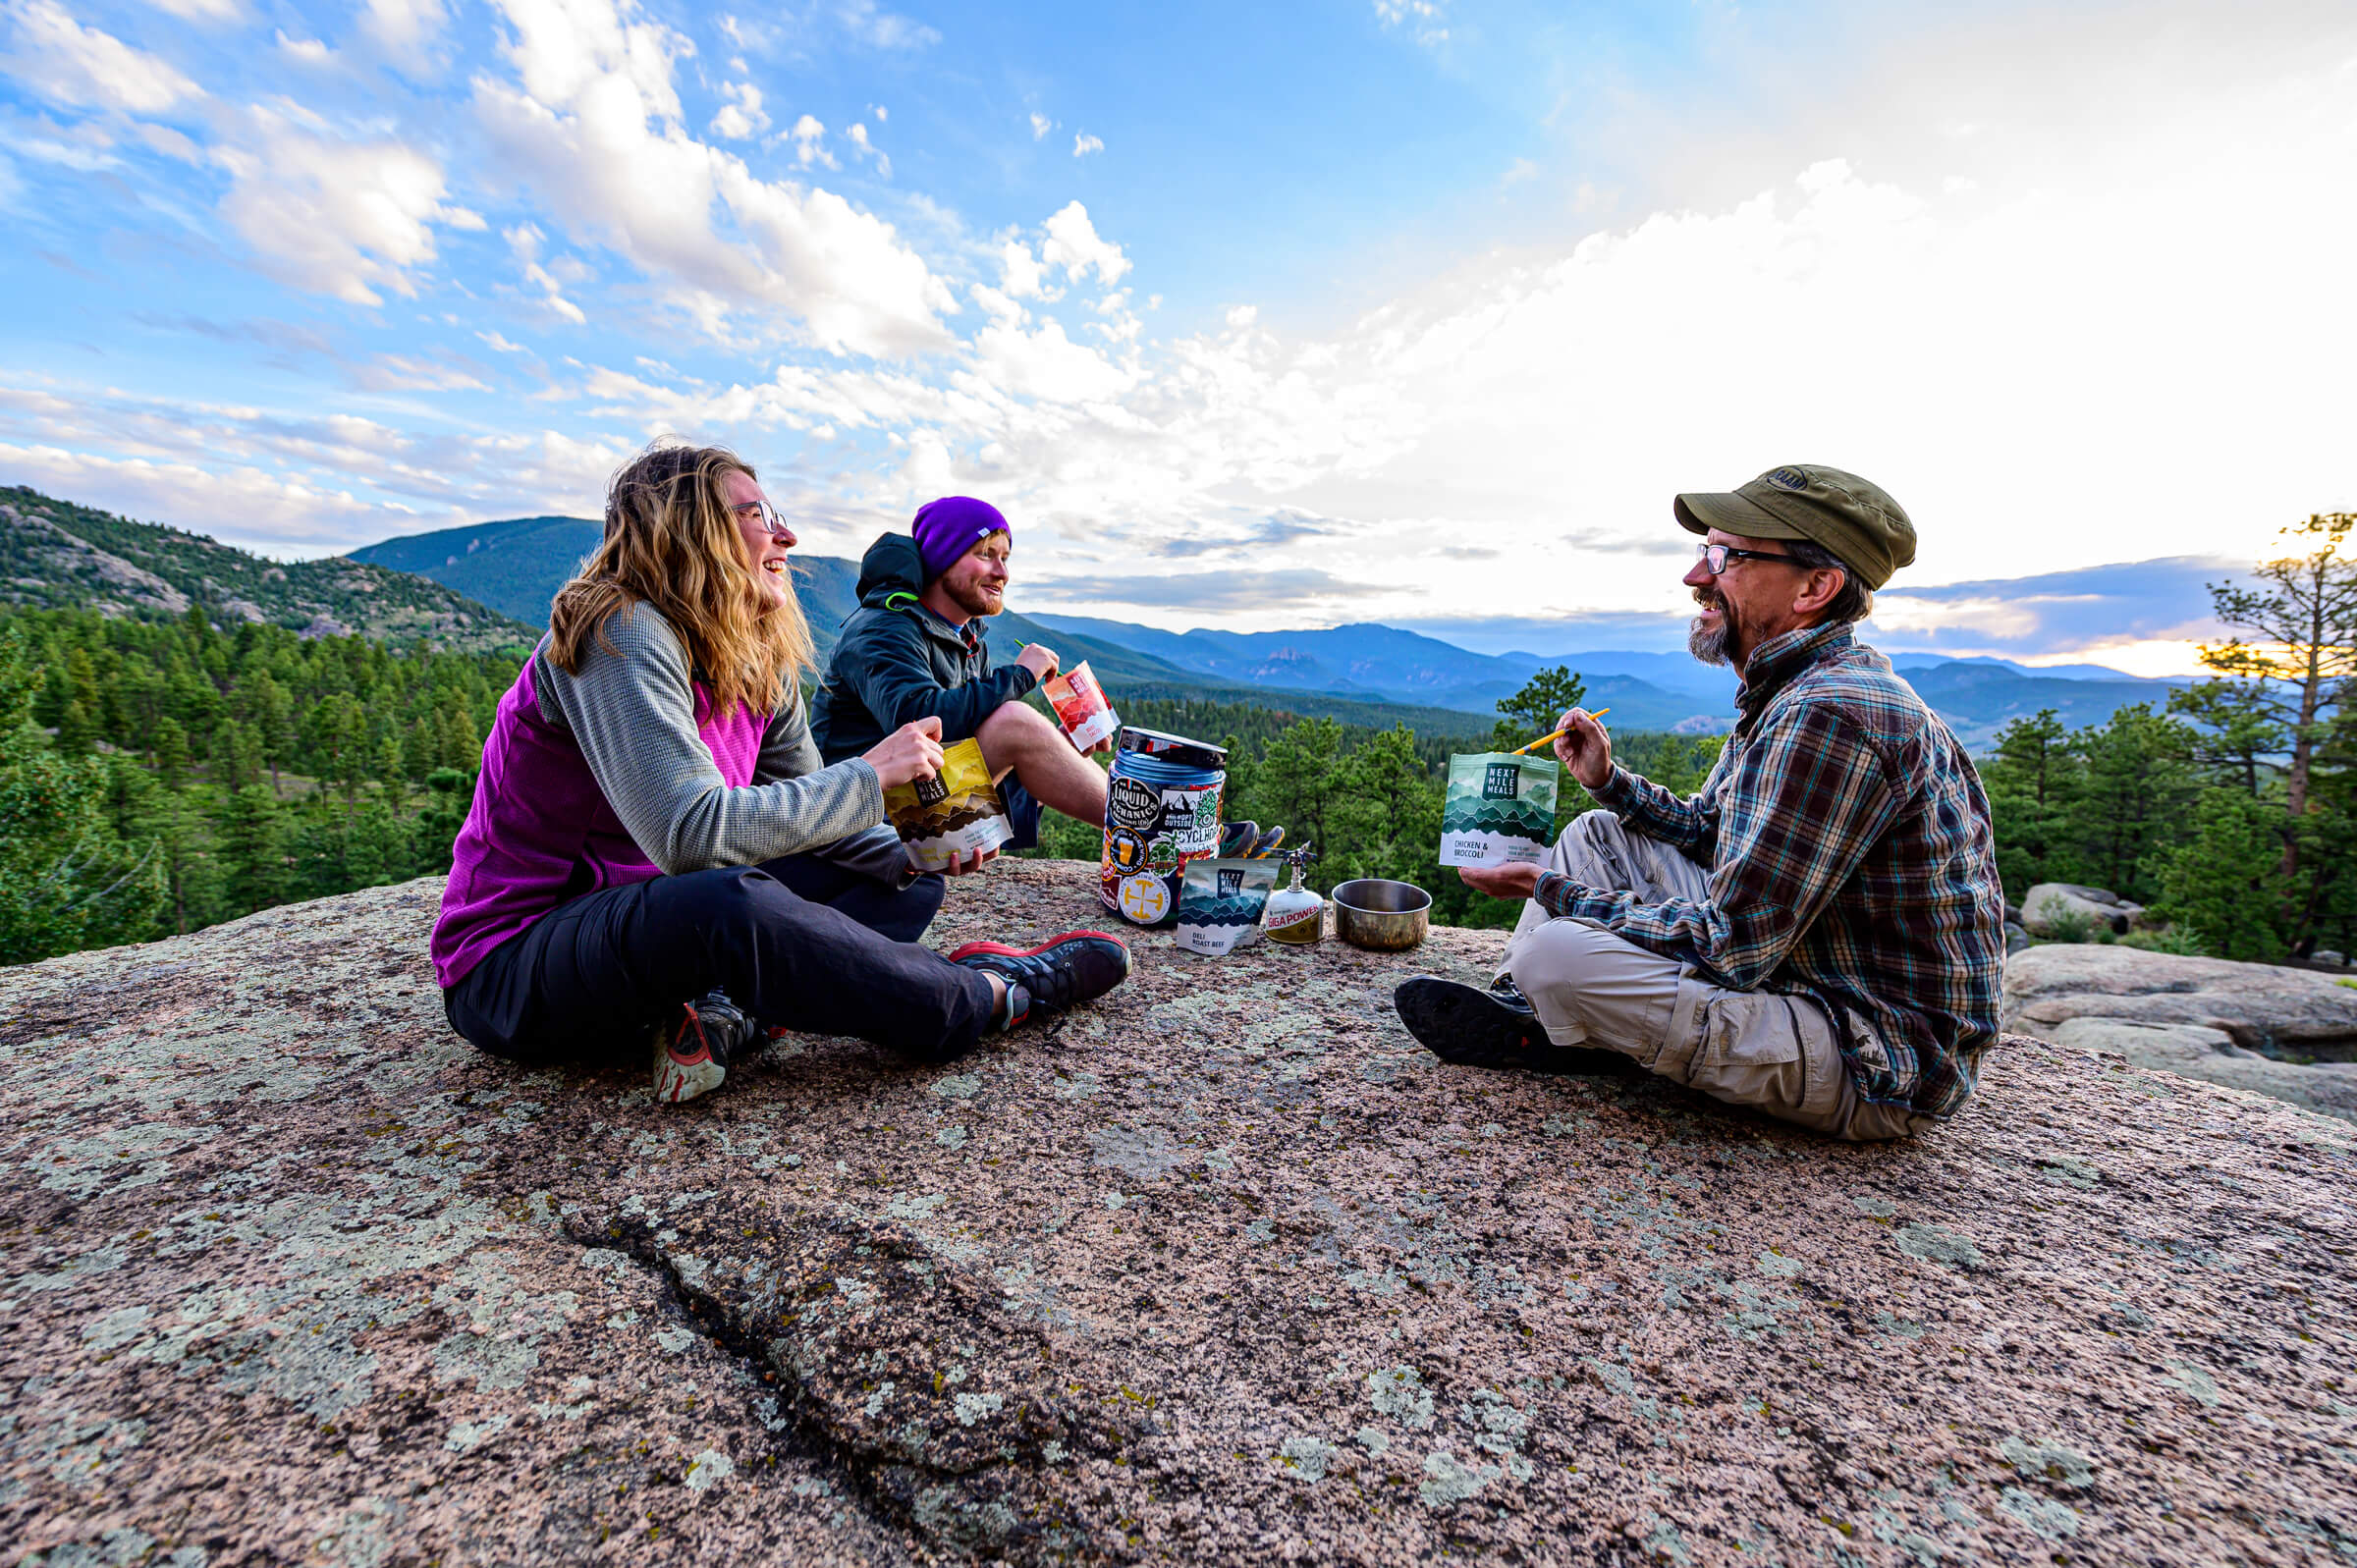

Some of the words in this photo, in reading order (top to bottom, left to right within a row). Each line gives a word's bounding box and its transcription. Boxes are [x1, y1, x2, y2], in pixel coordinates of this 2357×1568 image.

[1489, 768, 1515, 778] NEXT
[1488, 777, 1514, 786] MILE
[1487, 785, 1514, 795] MEALS
[1114, 784, 1149, 809] LIQUID
[1453, 839, 1481, 849] CHICKEN
[1453, 848, 1484, 859] BROCCOLI
[1268, 916, 1287, 928] GIGA
[1287, 903, 1319, 925] POWER
[1192, 939, 1210, 947] ROAST
